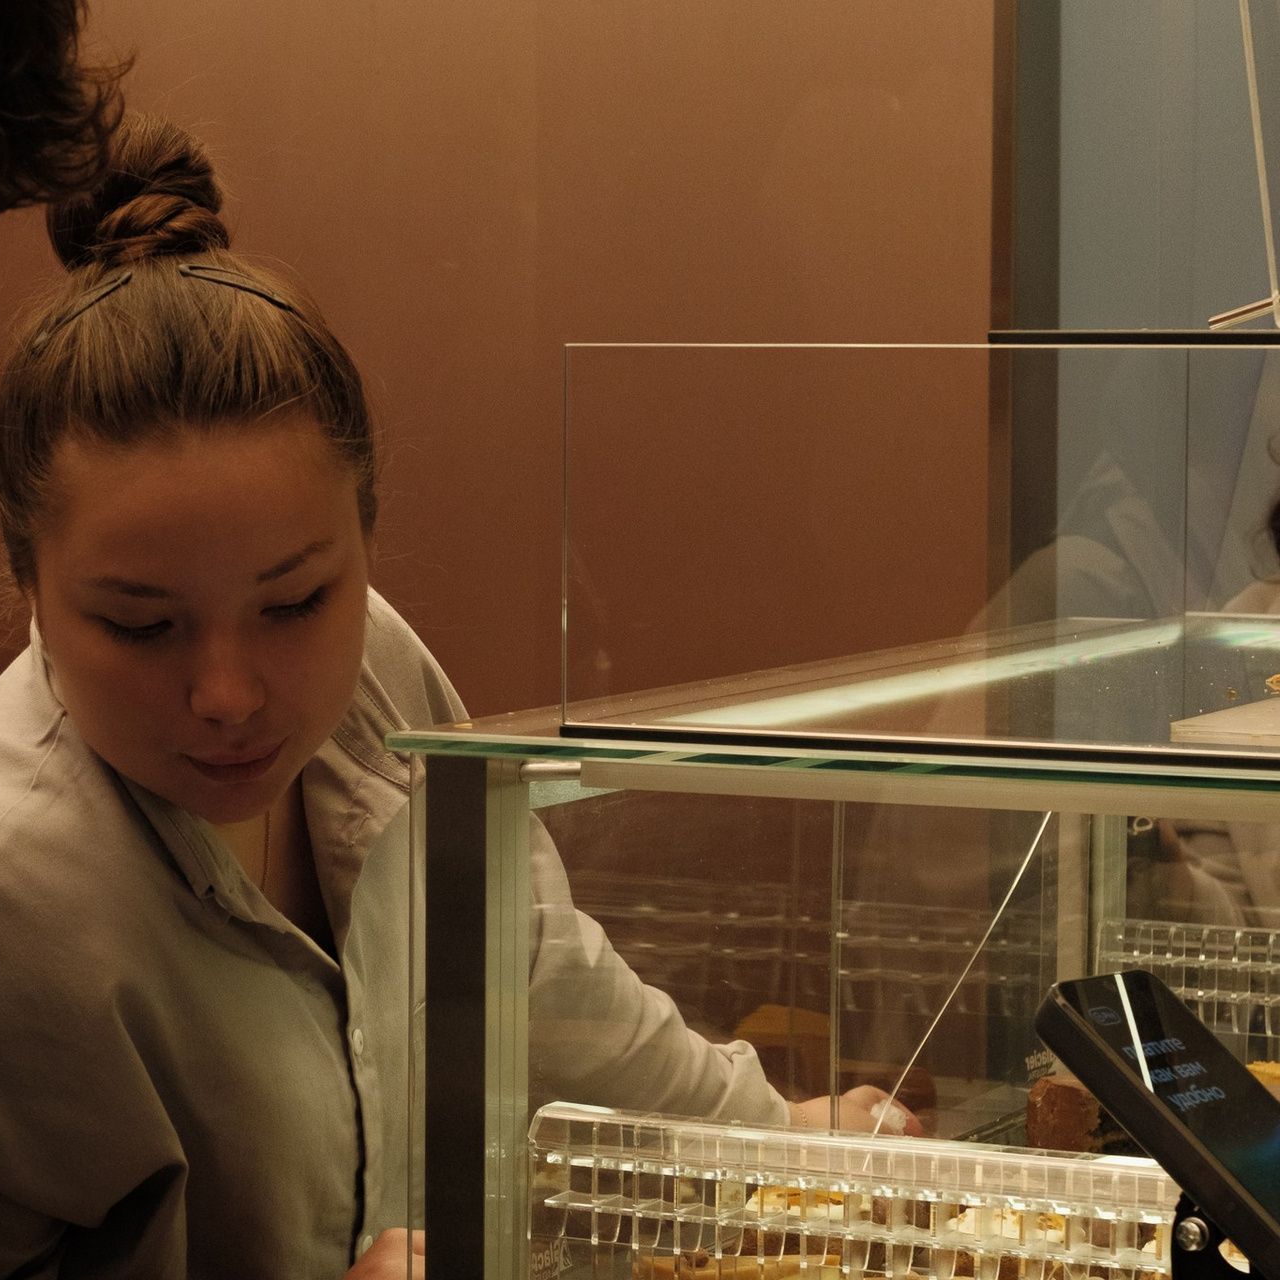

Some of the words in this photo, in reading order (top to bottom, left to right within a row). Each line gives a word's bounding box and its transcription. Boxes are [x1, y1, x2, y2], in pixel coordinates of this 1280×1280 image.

[1122, 1037, 1187, 1060] патите
[1147, 1066, 1178, 1085] как
[1175, 1060, 1208, 1080] вам
[1166, 1084, 1226, 1112] удобно
